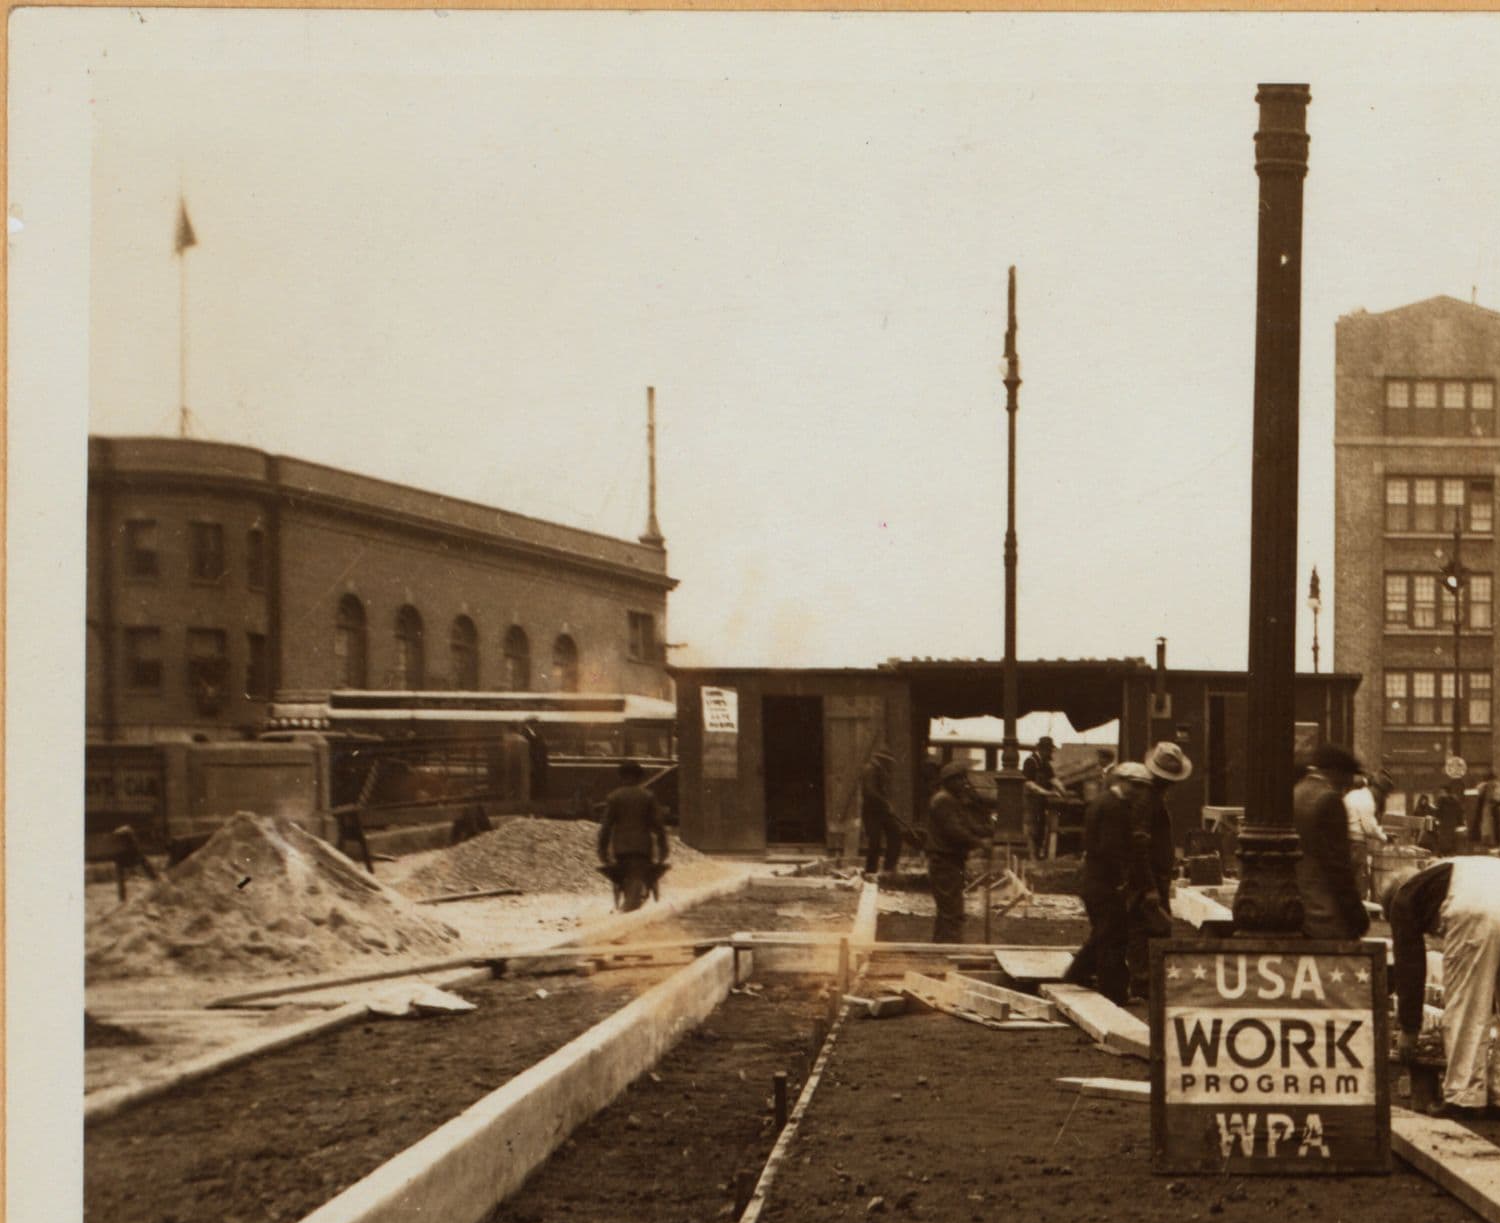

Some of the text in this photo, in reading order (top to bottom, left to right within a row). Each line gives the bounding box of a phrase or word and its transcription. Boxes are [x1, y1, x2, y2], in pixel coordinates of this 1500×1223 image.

[1215, 954, 1326, 1000] USA
[1174, 1017, 1364, 1069] WORK
[1181, 1074, 1359, 1094] PROGRAM
[1216, 1113, 1330, 1158] WPA
